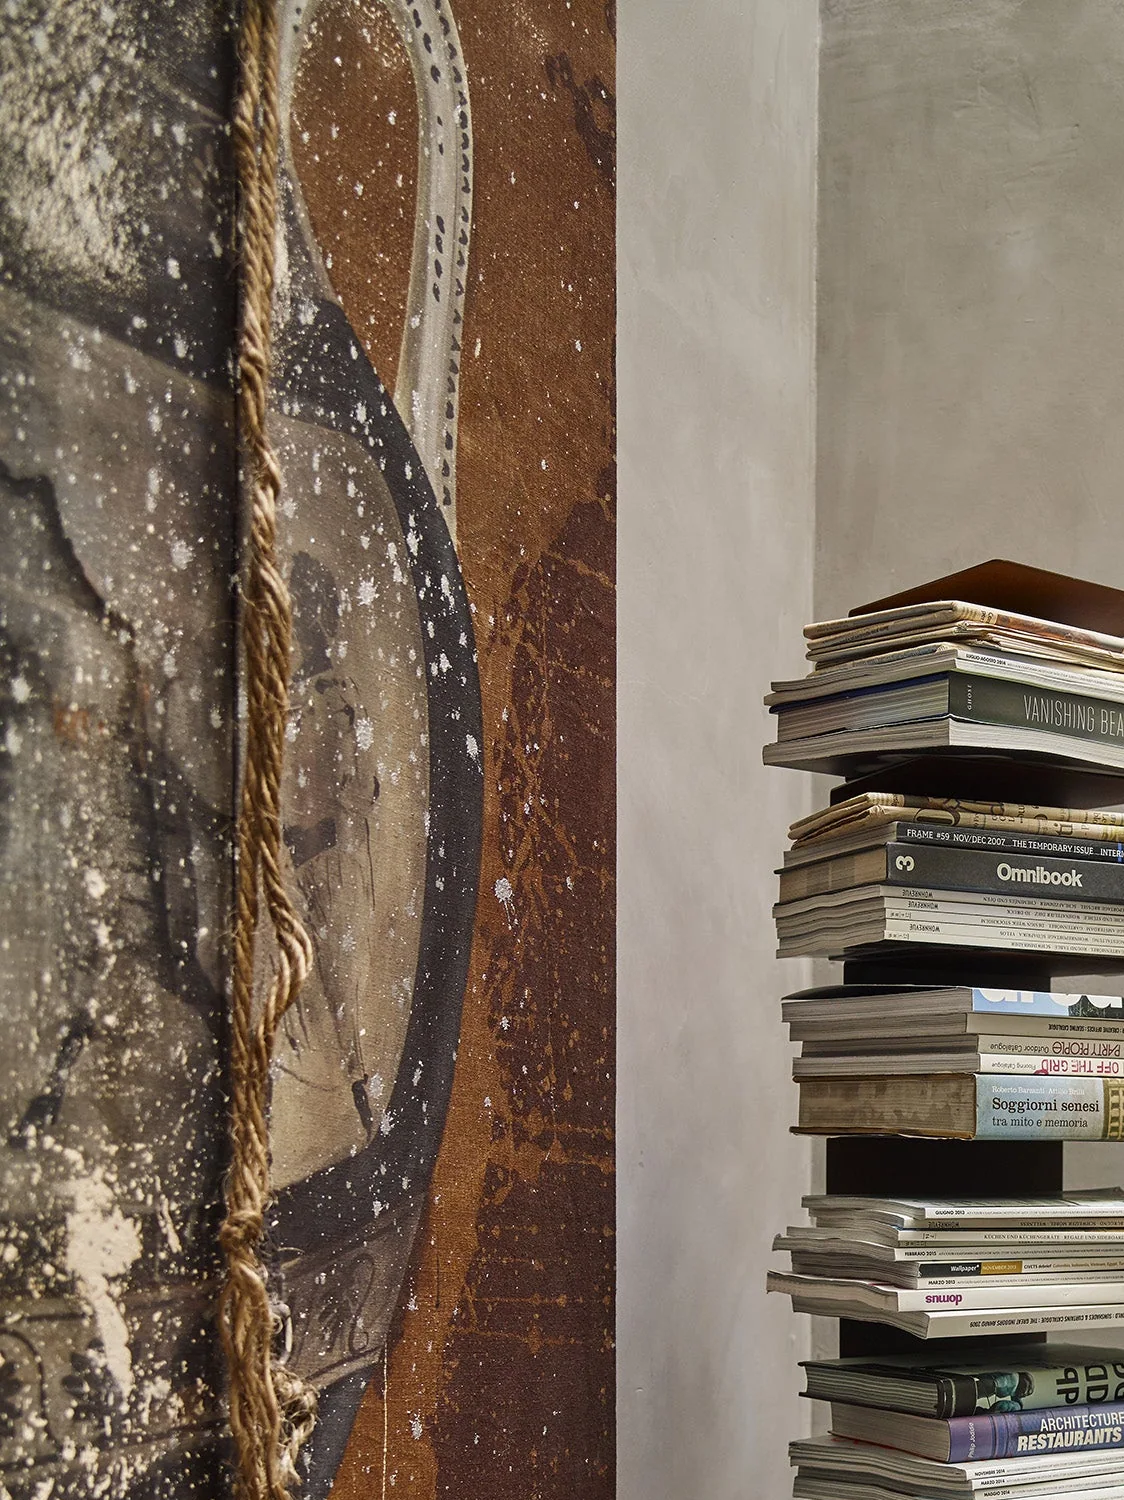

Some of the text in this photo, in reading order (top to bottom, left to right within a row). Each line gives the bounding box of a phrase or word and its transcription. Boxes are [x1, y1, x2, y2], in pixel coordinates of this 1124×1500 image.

[1024, 694, 1096, 733] VANISHING
[906, 828, 933, 839] FRAME
[936, 831, 949, 841] #59
[953, 833, 987, 844] NOV/DEC
[1012, 838, 1026, 848] THE
[1027, 840, 1073, 853] TEMPORARY
[1073, 845, 1093, 855] ISSUE
[895, 855, 915, 872] 3
[996, 862, 1083, 888] Omnibook
[989, 1041, 1022, 1051] Catalogue
[1024, 1045, 1049, 1053] Outdoor
[1090, 1042, 1120, 1057] PARTY
[1040, 1058, 1068, 1072] GRID
[1071, 1059, 1093, 1073] THE
[1096, 1060, 1119, 1074] OFF
[992, 1085, 1017, 1093] Roberto
[992, 1096, 1099, 1114] Soggiorni senesi
[992, 1116, 1087, 1128] tra mito e memoria
[924, 1293, 962, 1306] domus
[1017, 1425, 1122, 1452] RESTAURANTS
